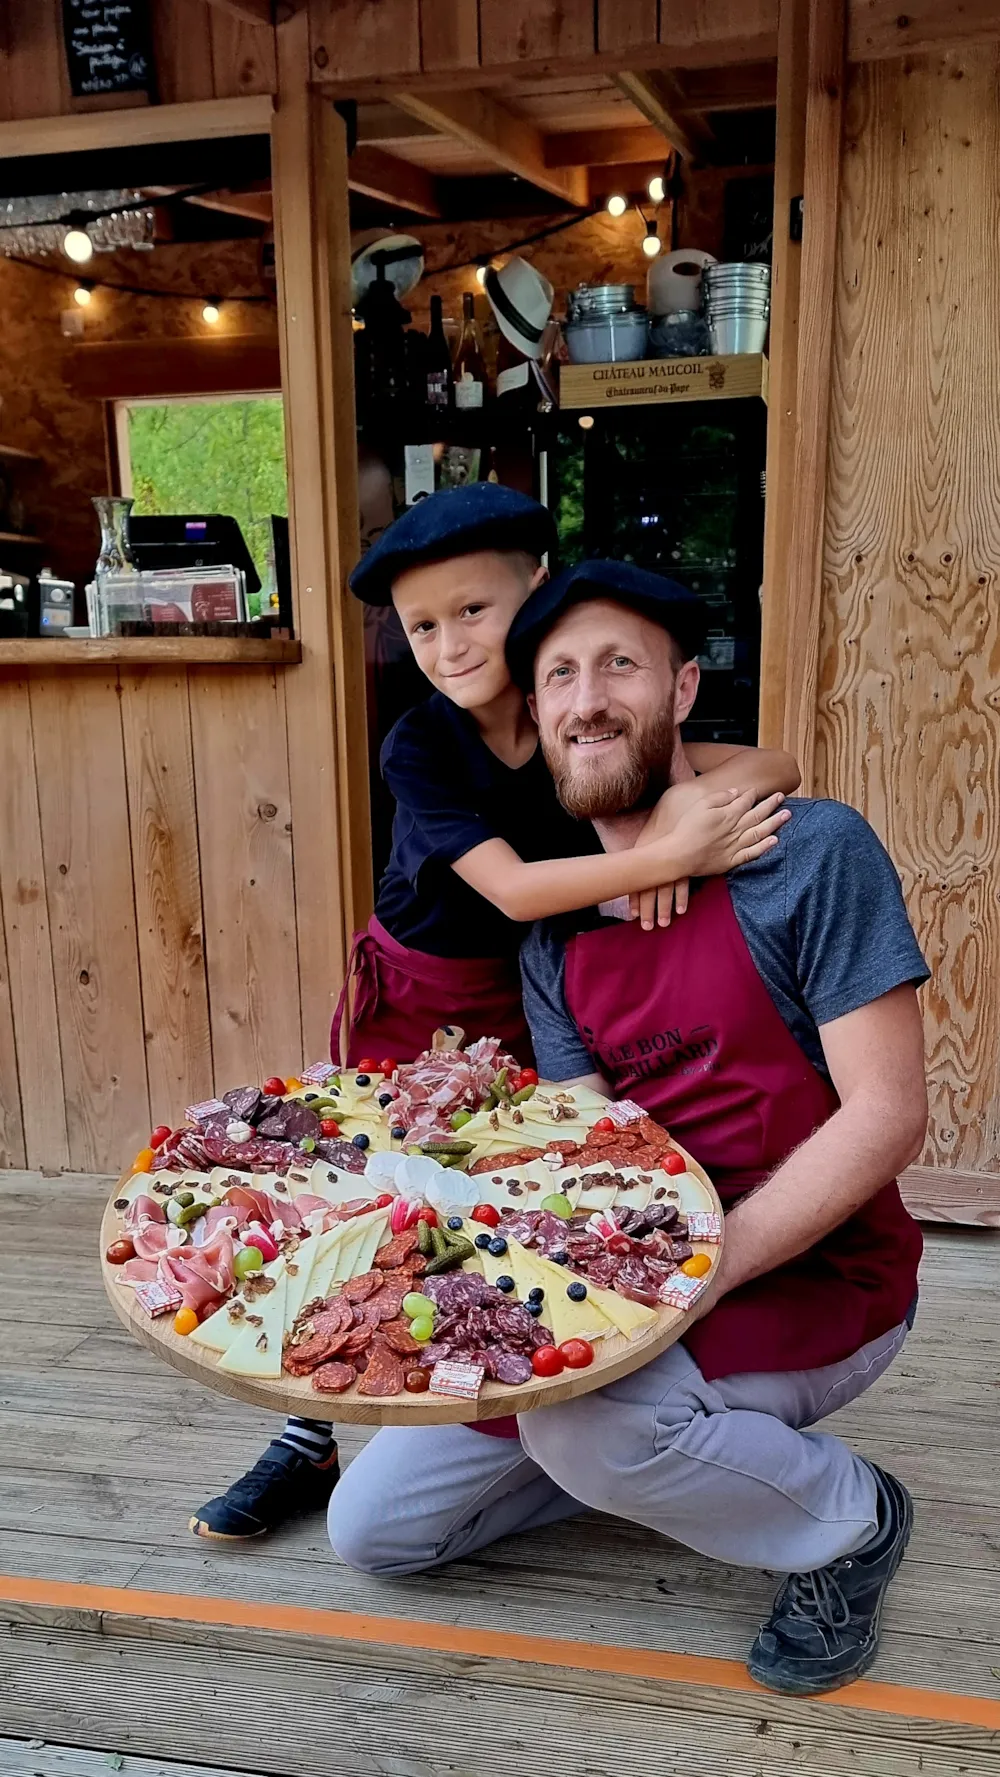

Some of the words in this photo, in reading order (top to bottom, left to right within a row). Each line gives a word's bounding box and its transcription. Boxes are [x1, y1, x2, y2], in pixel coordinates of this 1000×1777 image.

[592, 366, 645, 381] CHÂTEAU
[648, 363, 704, 377] MAUCOIL
[609, 1043, 635, 1063] LE
[636, 1028, 684, 1057] BON
[615, 1038, 719, 1080] AILLARD
